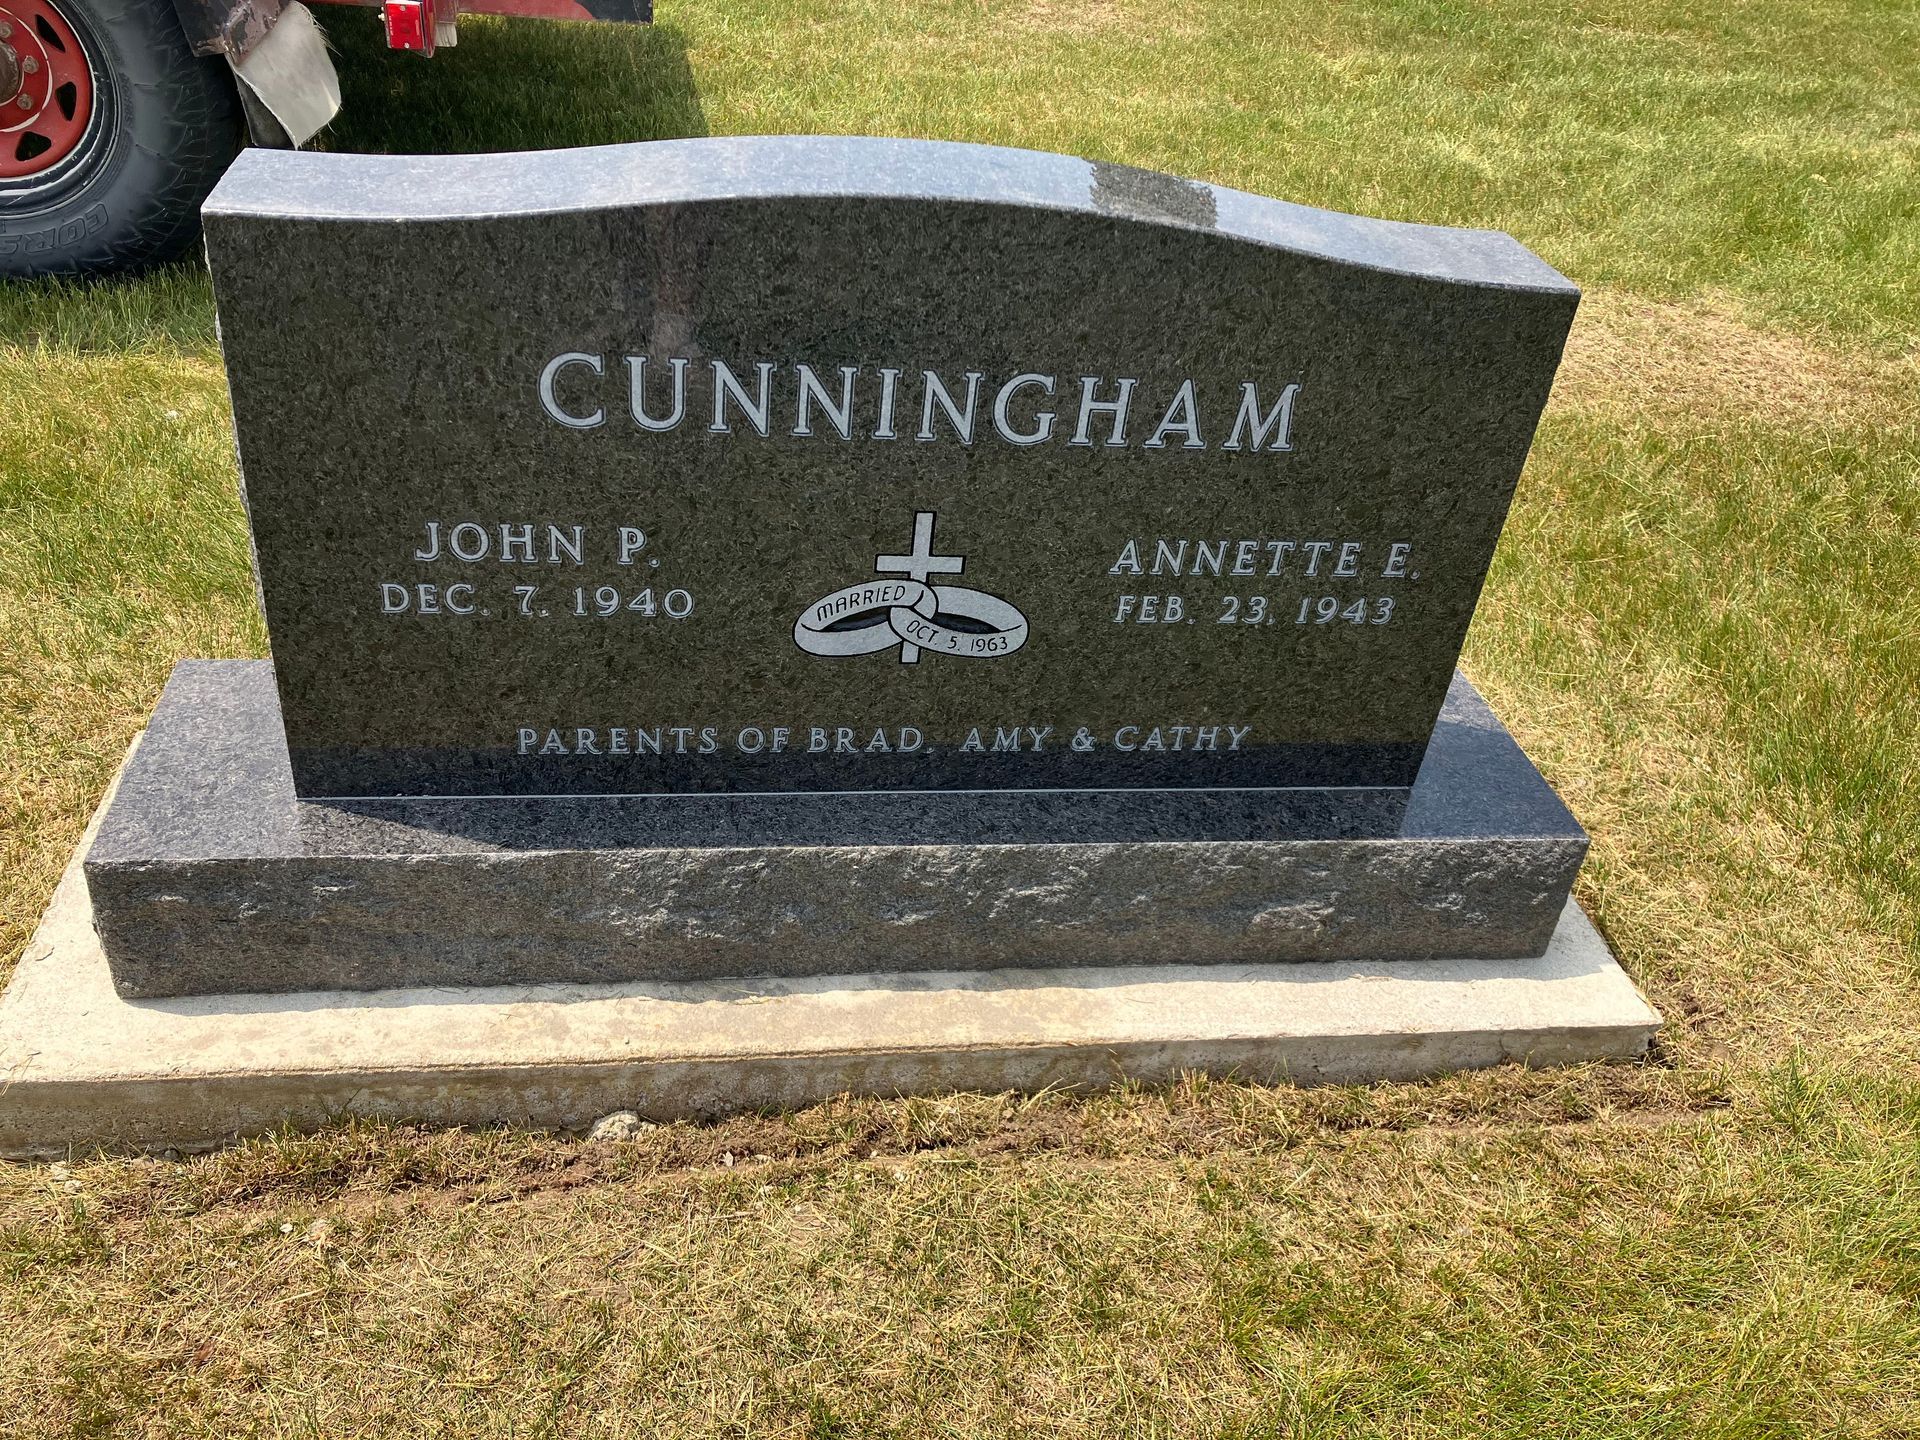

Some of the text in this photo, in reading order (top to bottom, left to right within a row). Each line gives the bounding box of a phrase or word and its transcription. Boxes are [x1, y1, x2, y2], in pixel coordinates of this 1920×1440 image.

[538, 351, 1302, 452] CUNNINGHAM
[414, 521, 661, 568] JOHN P.
[1107, 538, 1421, 580] ANNETTE E.
[379, 583, 491, 616] DEC.
[572, 586, 695, 619] 1940
[816, 585, 906, 622] MARRIED
[1113, 595, 1197, 625] FEB.
[1295, 596, 1396, 626] 1943
[906, 619, 939, 646] OCT.
[970, 636, 1009, 653] 1963
[516, 727, 719, 756] PARENTS
[736, 727, 791, 754] OF
[958, 726, 1054, 753] AMY
[1070, 726, 1097, 752] &
[1113, 726, 1252, 752] CATHY
